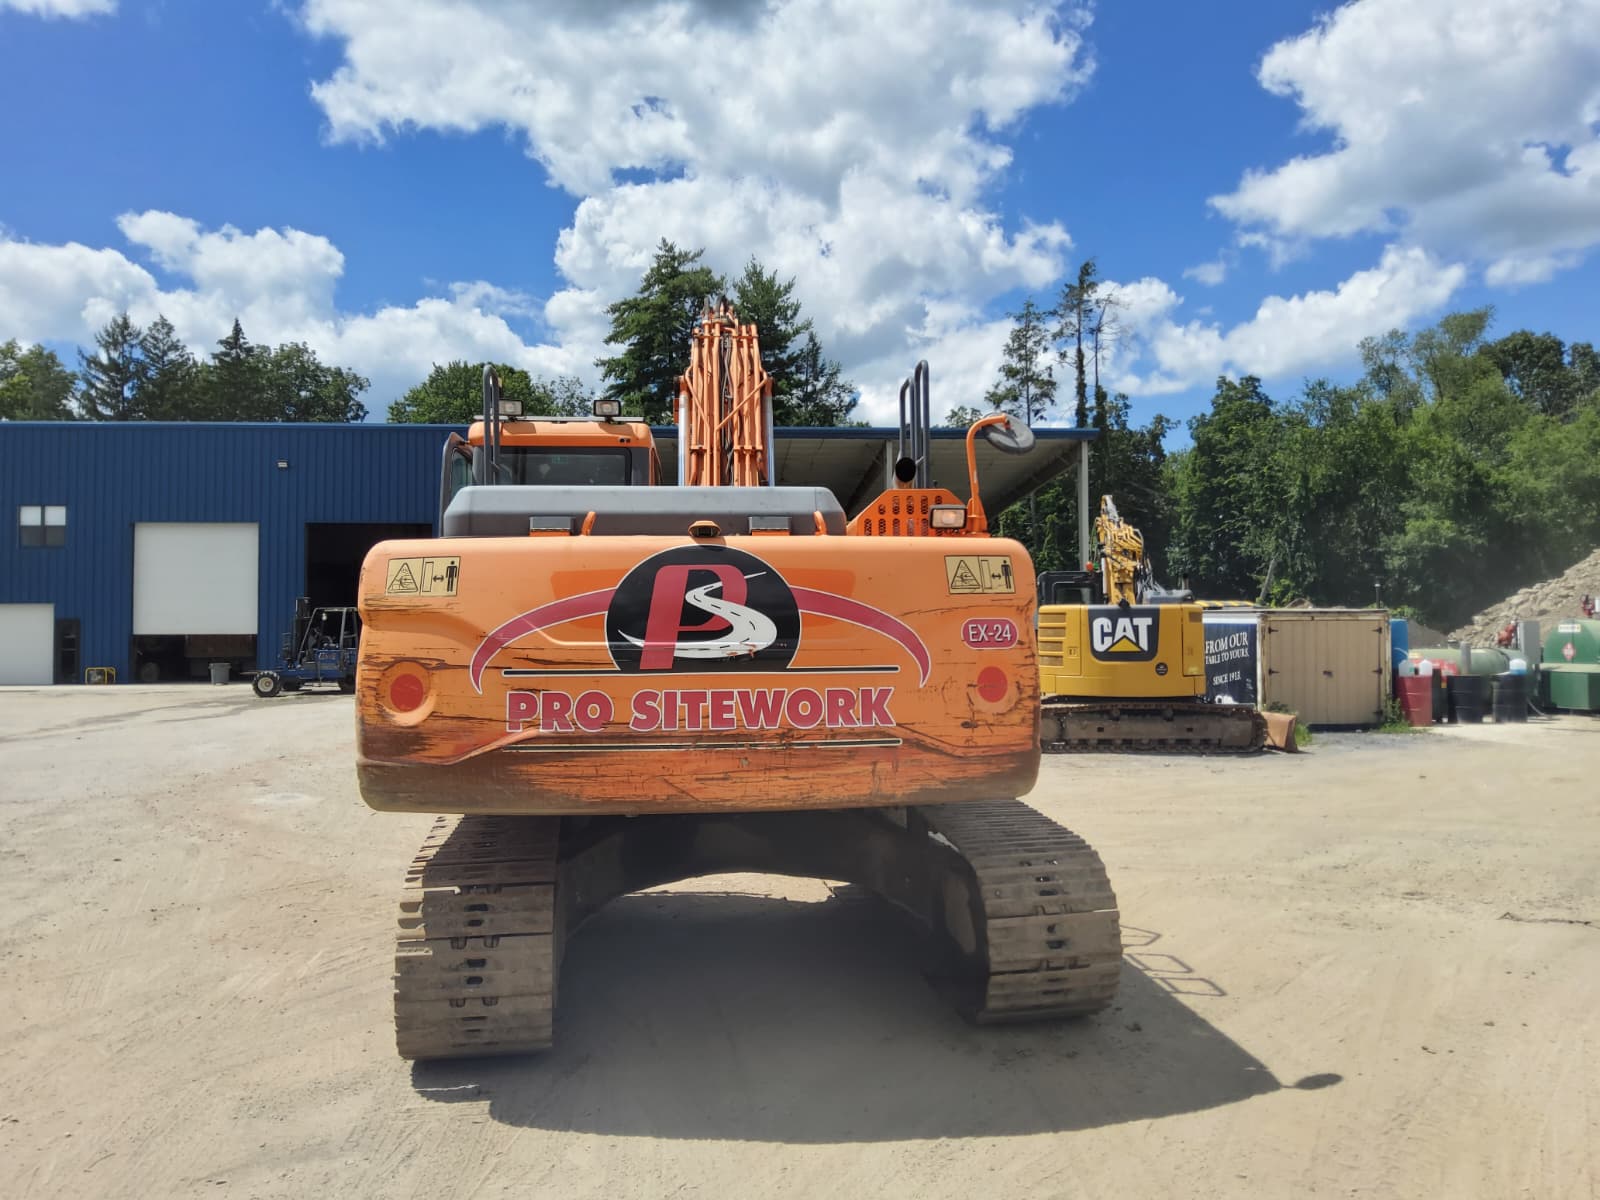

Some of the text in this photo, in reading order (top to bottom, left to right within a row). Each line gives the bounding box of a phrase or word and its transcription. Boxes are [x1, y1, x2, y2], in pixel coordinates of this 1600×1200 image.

[968, 623, 1011, 642] EX-24
[1092, 616, 1153, 652] CAT
[1205, 631, 1249, 654] FROM OUR
[1221, 651, 1229, 662] TO
[1212, 673, 1228, 686] SINCE
[506, 687, 897, 733] PRO SITEWORK
